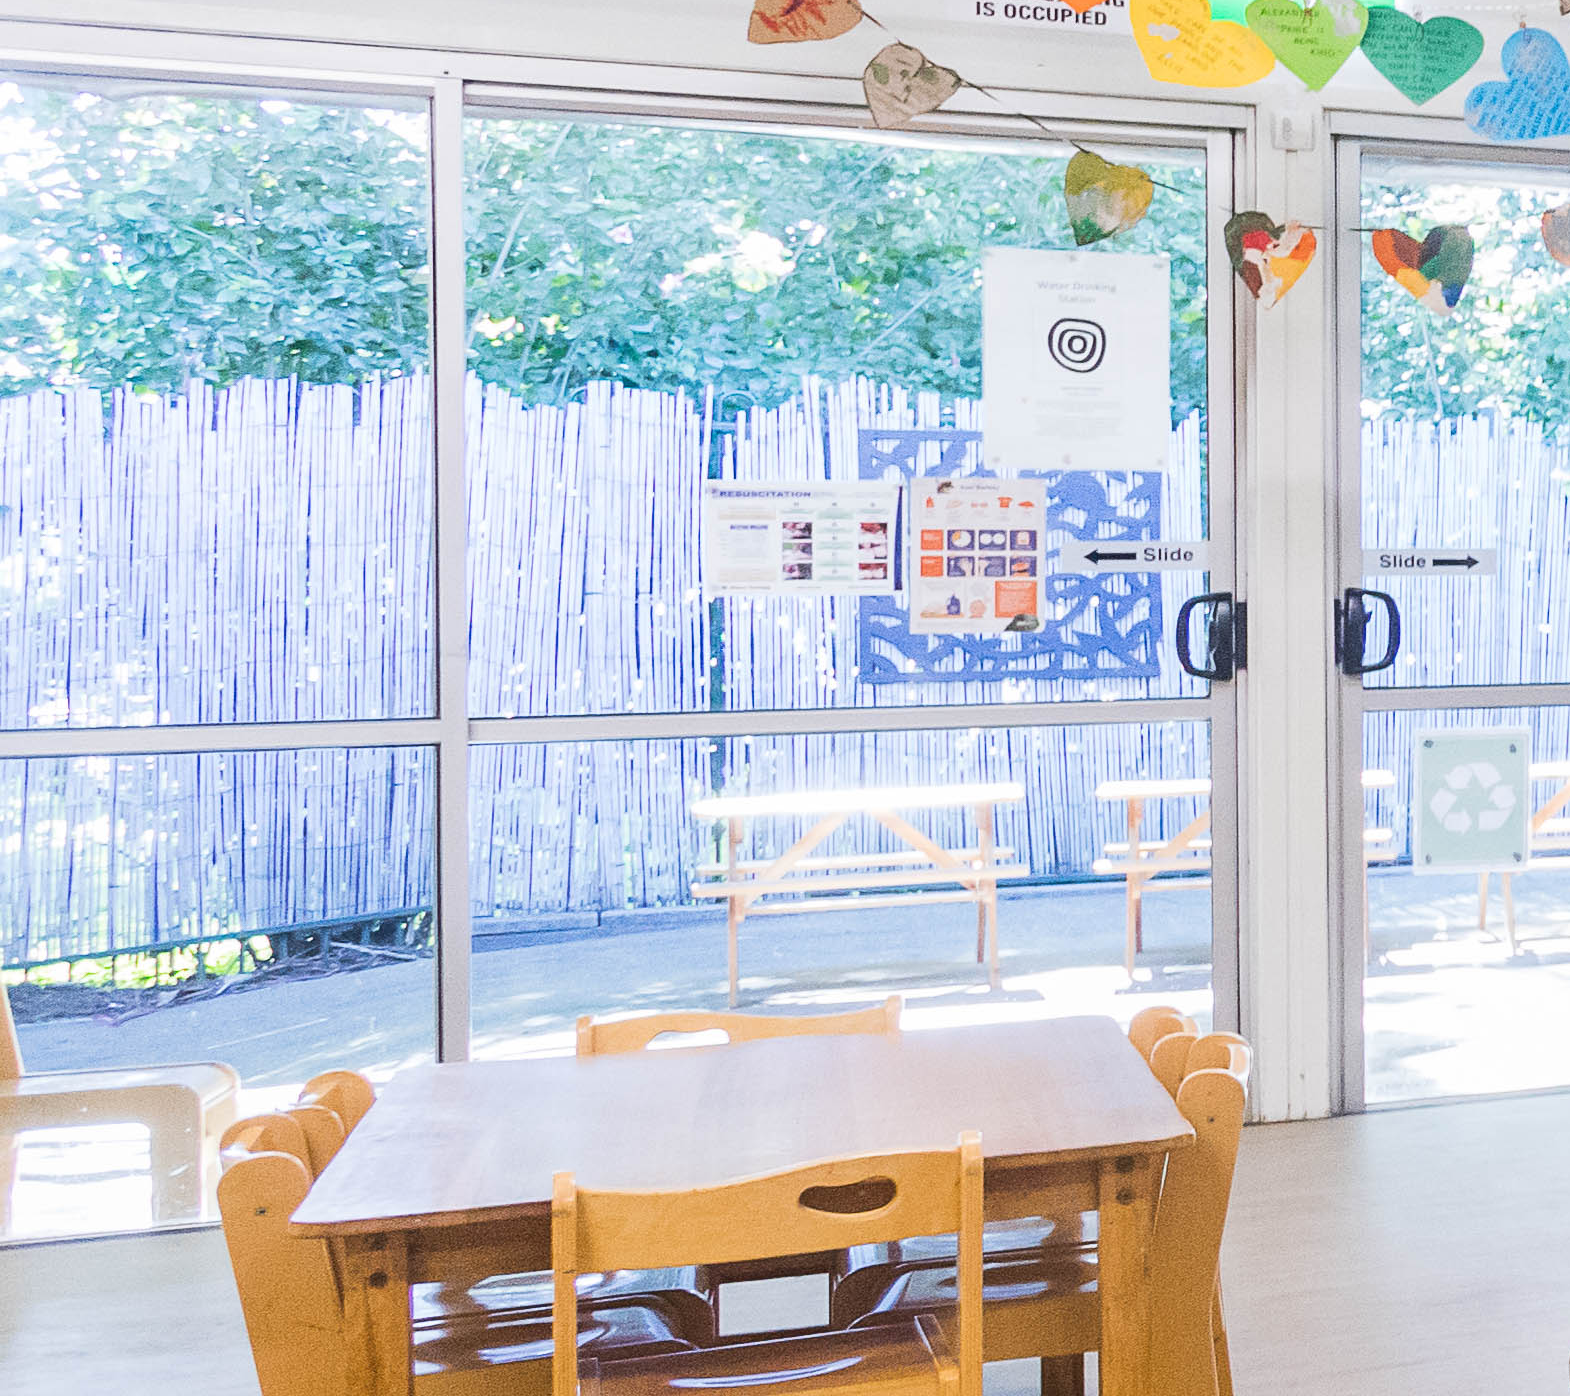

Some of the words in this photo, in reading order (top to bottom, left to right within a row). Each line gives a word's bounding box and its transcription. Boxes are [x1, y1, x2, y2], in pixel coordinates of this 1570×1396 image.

[976, 1, 996, 17] IS
[1004, 4, 1108, 26] OCCUPIED
[718, 489, 812, 499] RESUSCITATION
[1143, 547, 1194, 563] Slide
[1379, 553, 1427, 569] Slide
